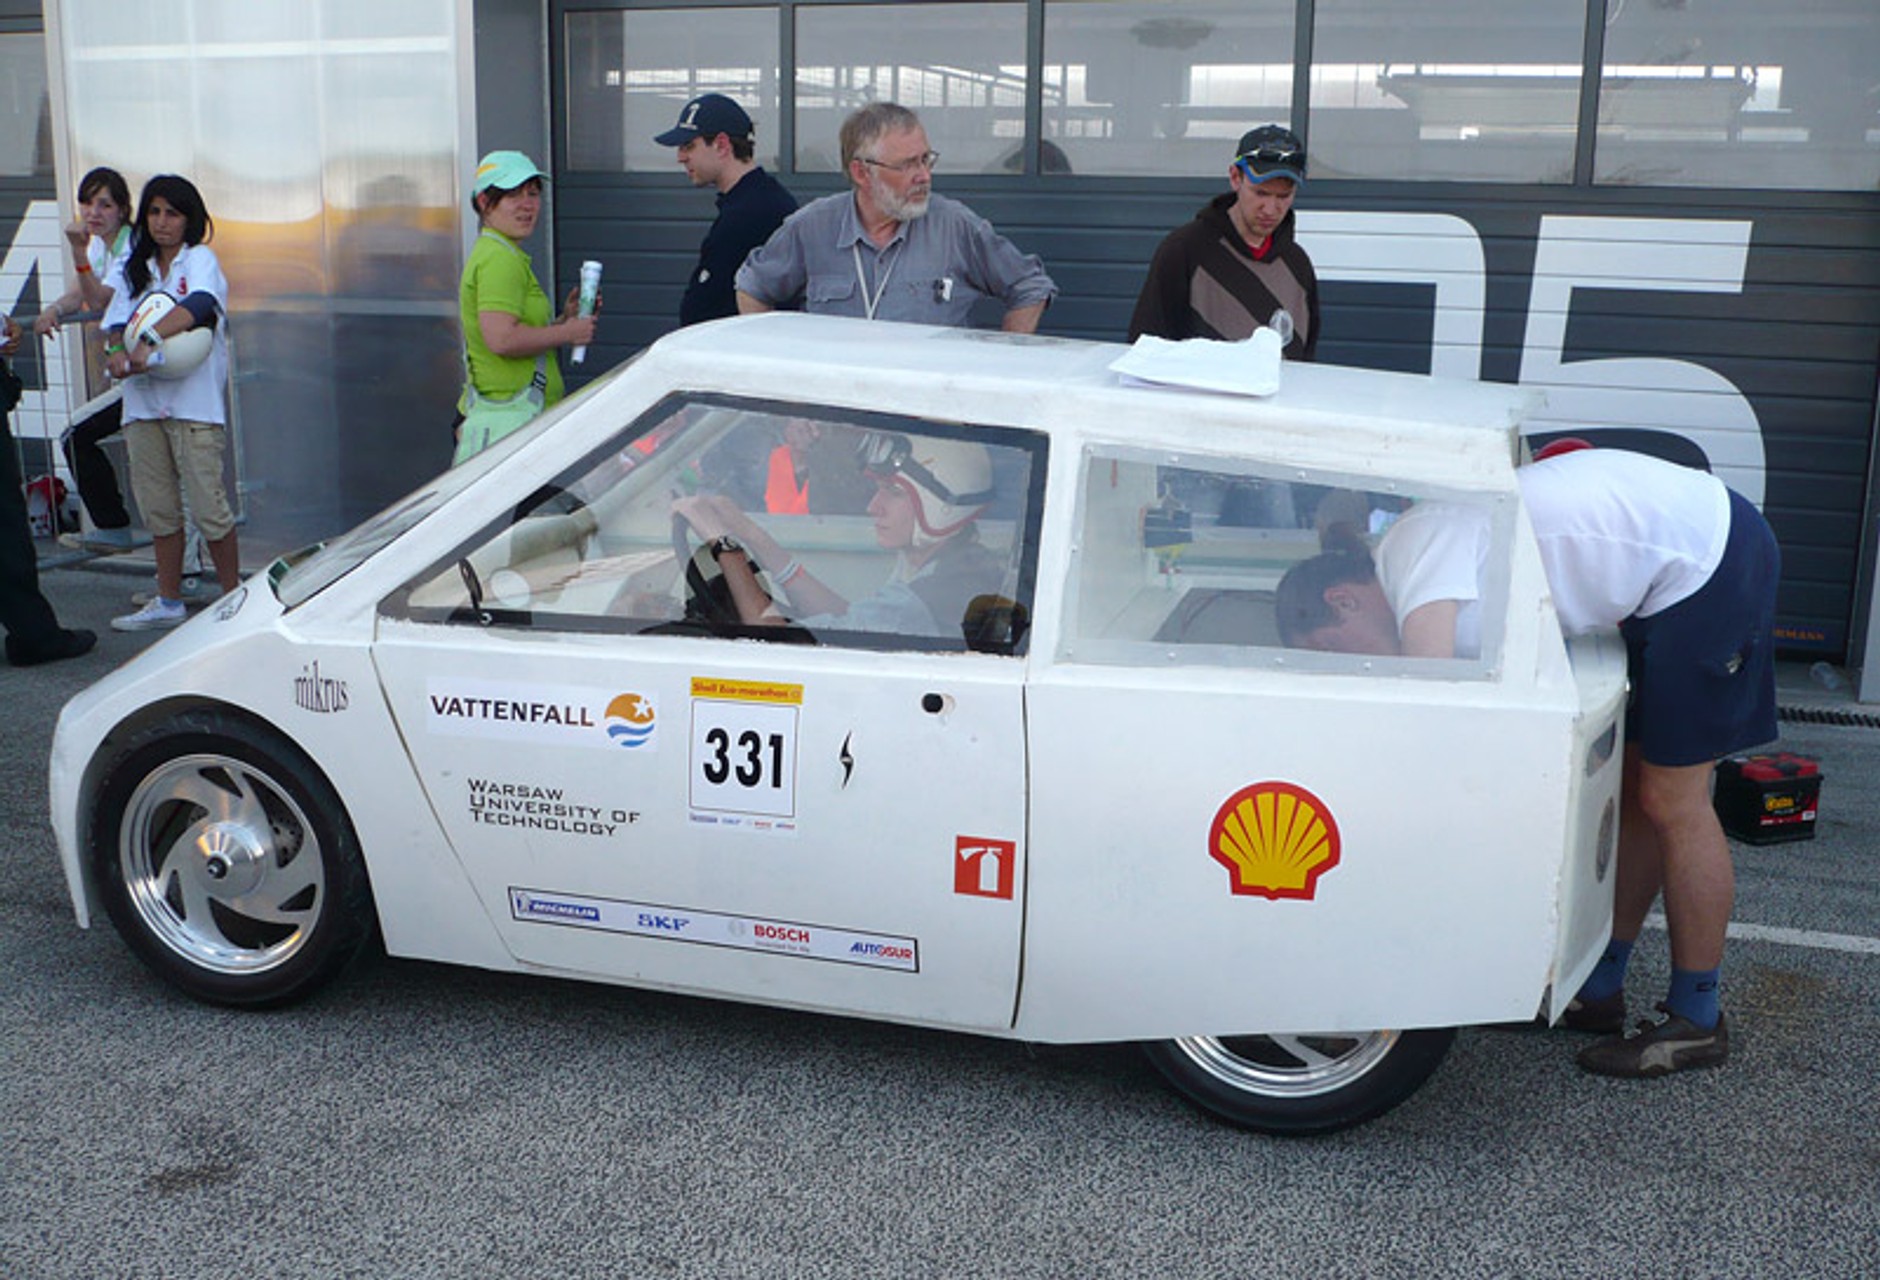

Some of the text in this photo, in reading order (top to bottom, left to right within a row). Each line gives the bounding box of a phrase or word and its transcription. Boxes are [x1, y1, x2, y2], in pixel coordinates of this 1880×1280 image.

[293, 660, 349, 713] mikrus
[430, 695, 595, 727] VATTENFALL
[703, 727, 784, 789] 331
[467, 778, 563, 800] WARSAW
[469, 794, 641, 824] UNIVERSITY OF
[469, 808, 617, 837] TECHNOLOGY
[532, 902, 597, 918] MICHELIN
[637, 913, 690, 931] SKF
[754, 924, 810, 943] BOSCH
[849, 942, 913, 960] AUTOSUR
